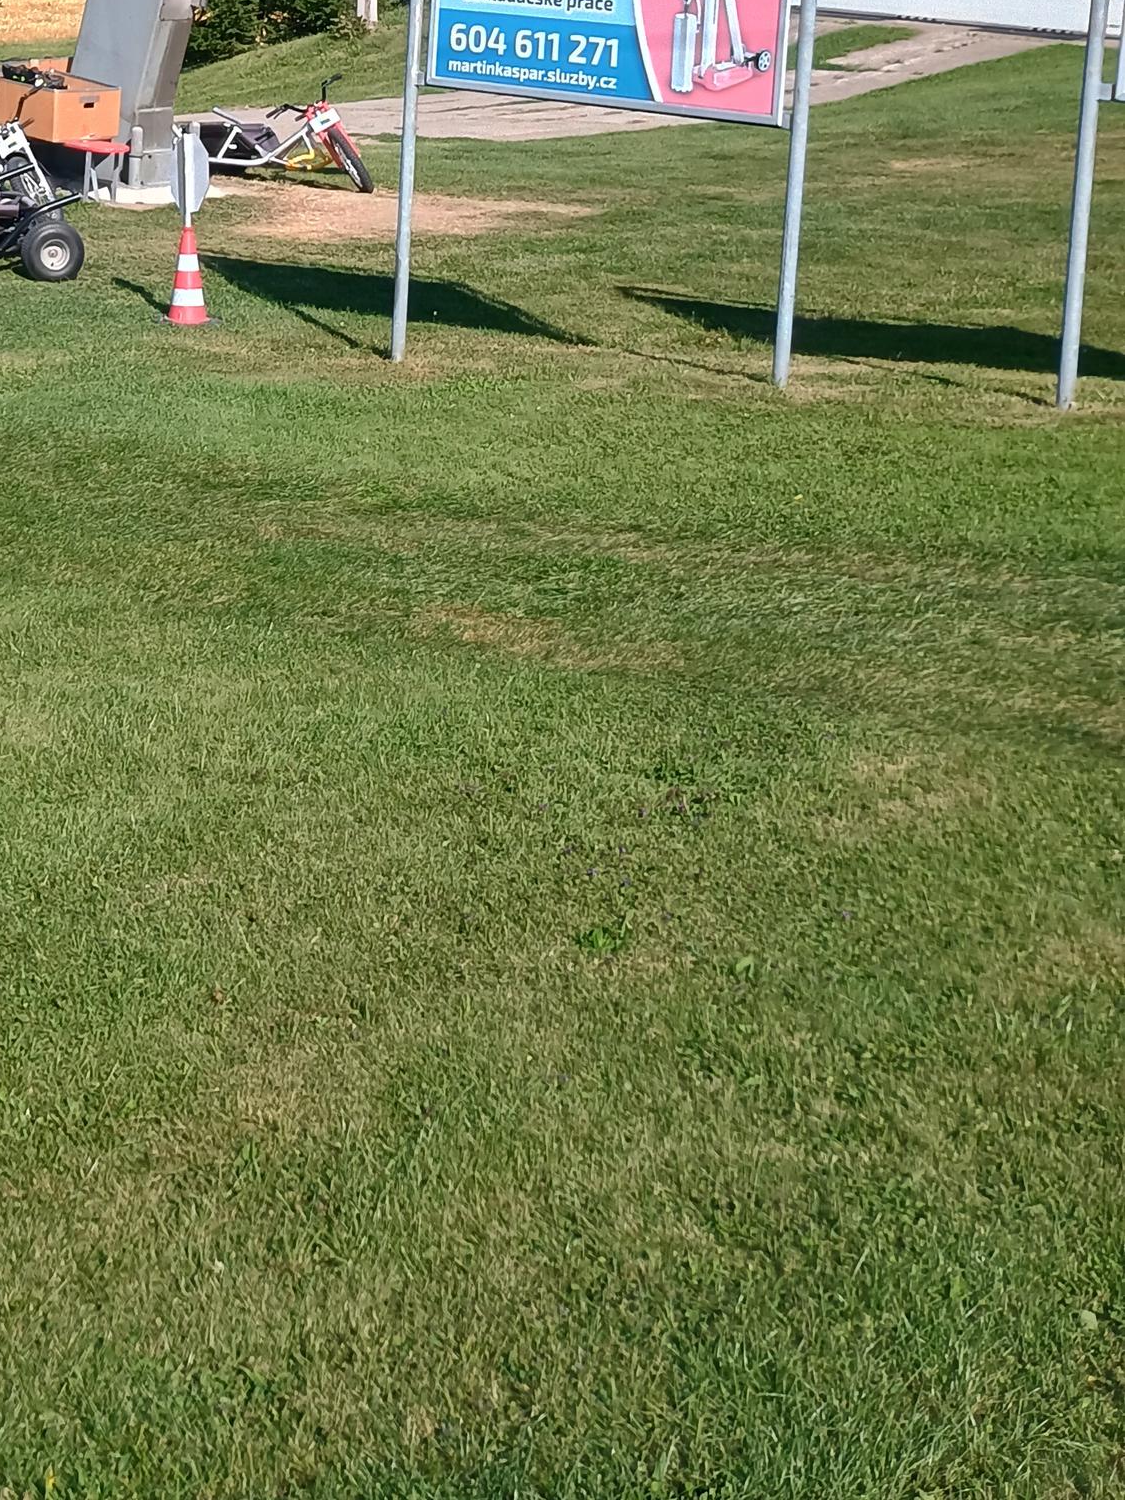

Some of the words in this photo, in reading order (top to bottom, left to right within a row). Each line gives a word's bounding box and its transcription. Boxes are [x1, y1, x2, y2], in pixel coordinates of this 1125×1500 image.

[450, 23, 507, 56] 604
[515, 30, 560, 61] 611
[568, 34, 619, 68] 271
[447, 59, 617, 90] martinkaspar.sluzby.cz
